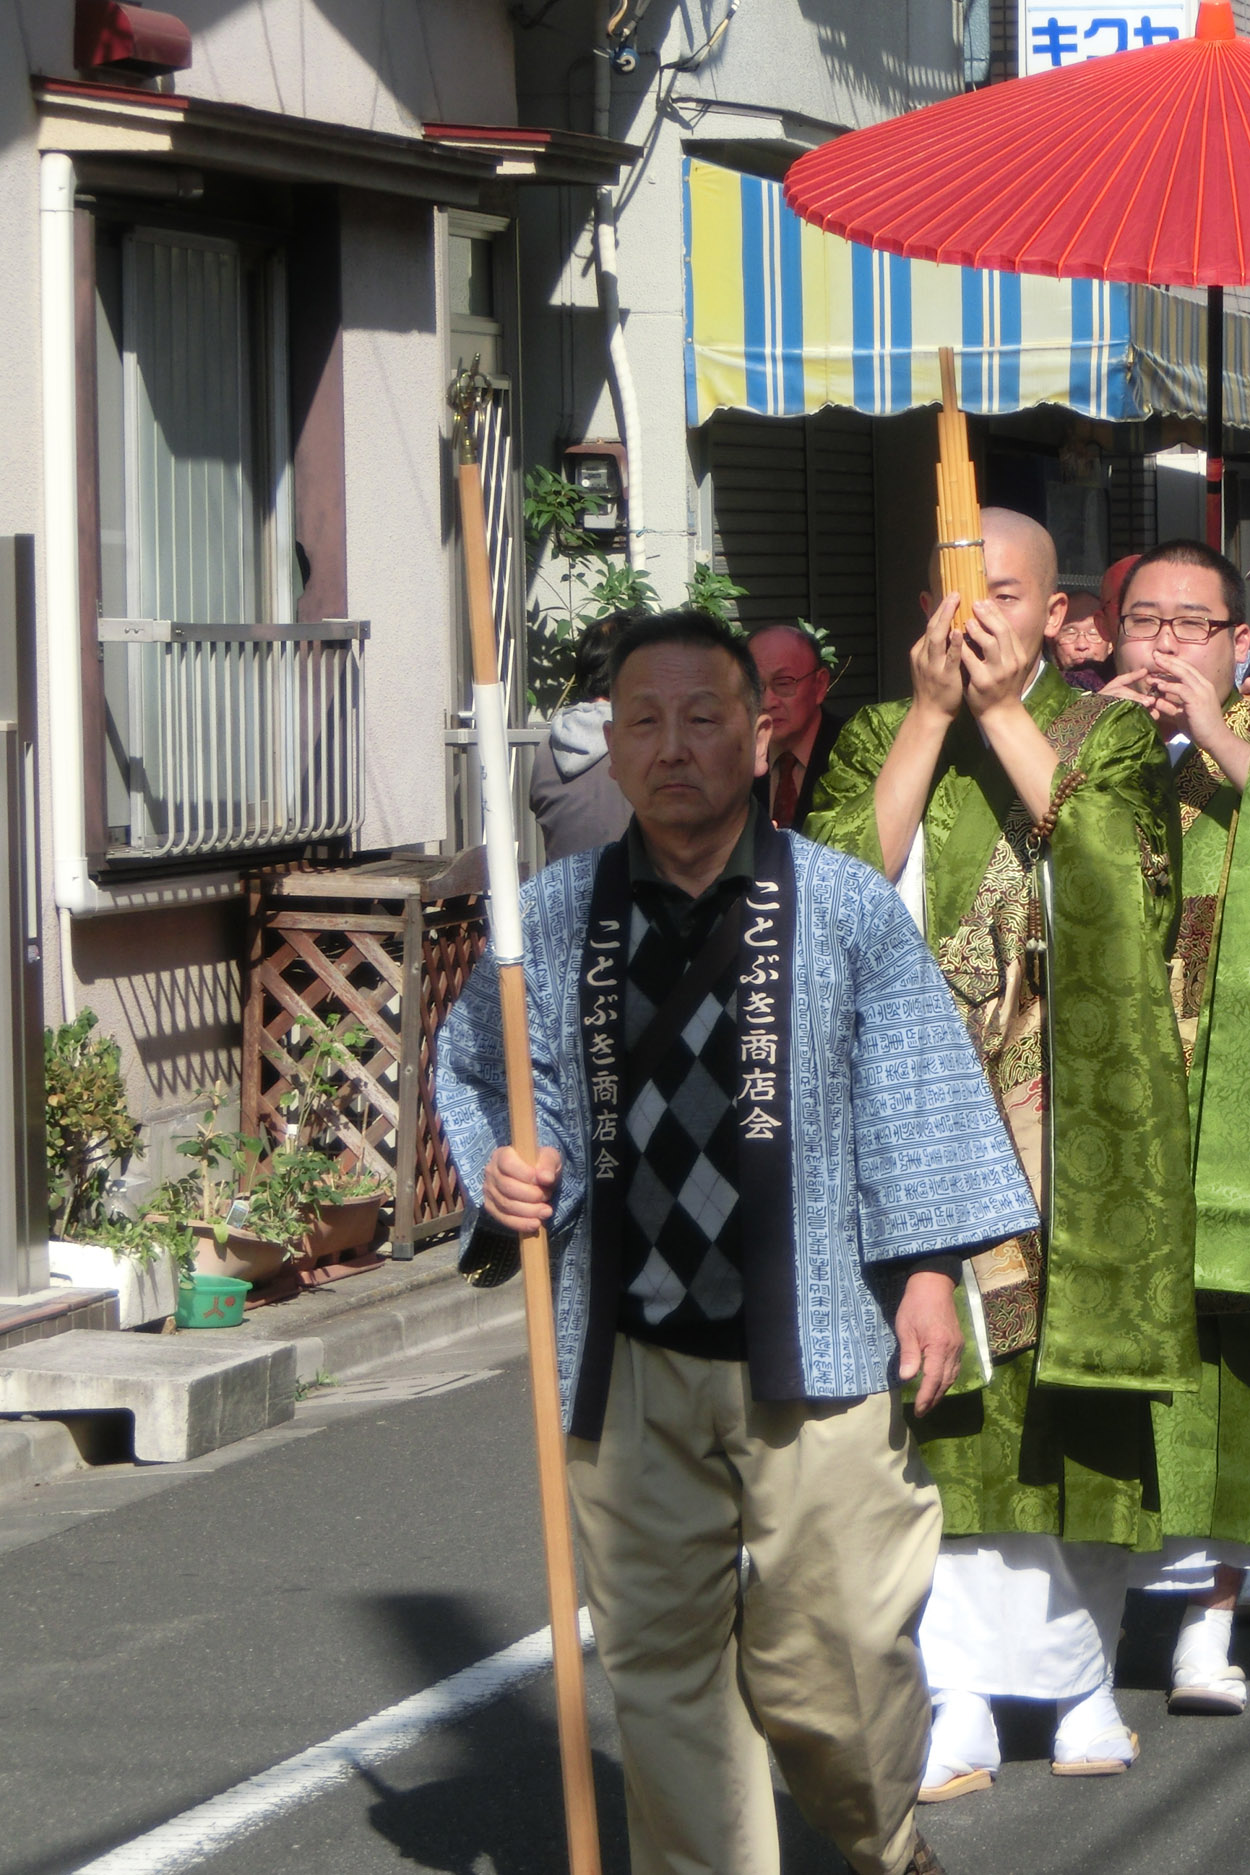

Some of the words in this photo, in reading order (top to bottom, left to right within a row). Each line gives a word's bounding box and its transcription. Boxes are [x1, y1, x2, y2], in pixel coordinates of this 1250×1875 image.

[584, 919, 620, 1179] ことぶき商店会
[738, 880, 782, 1139] ことぶき商店会
